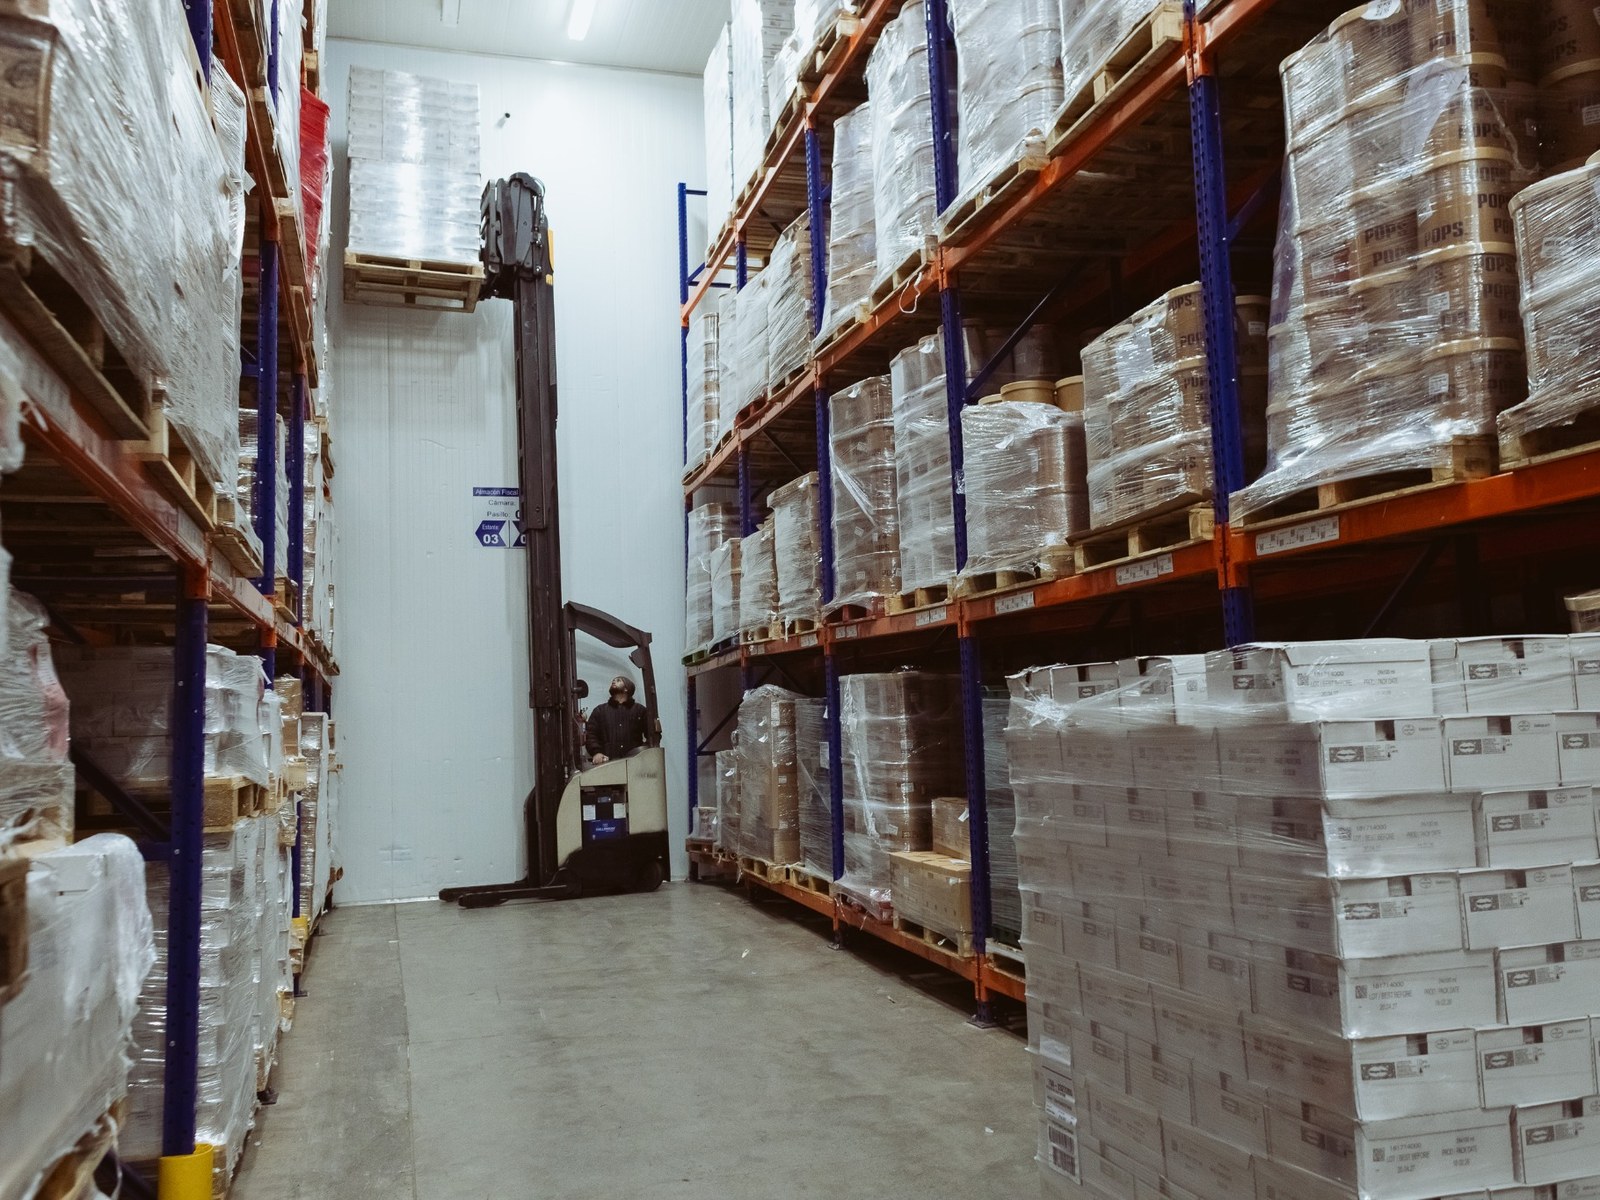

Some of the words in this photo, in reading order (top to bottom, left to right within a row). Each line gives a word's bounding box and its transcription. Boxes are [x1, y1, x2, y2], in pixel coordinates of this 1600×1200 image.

[486, 510, 511, 518] Pasillo:
[483, 534, 499, 544] 03
[520, 534, 526, 543] 0
[1394, 990, 1412, 998] BEFORE
[1390, 1143, 1422, 1151] 181714000
[1386, 1155, 1395, 1163] LOT
[1411, 1151, 1430, 1160] BEFORE
